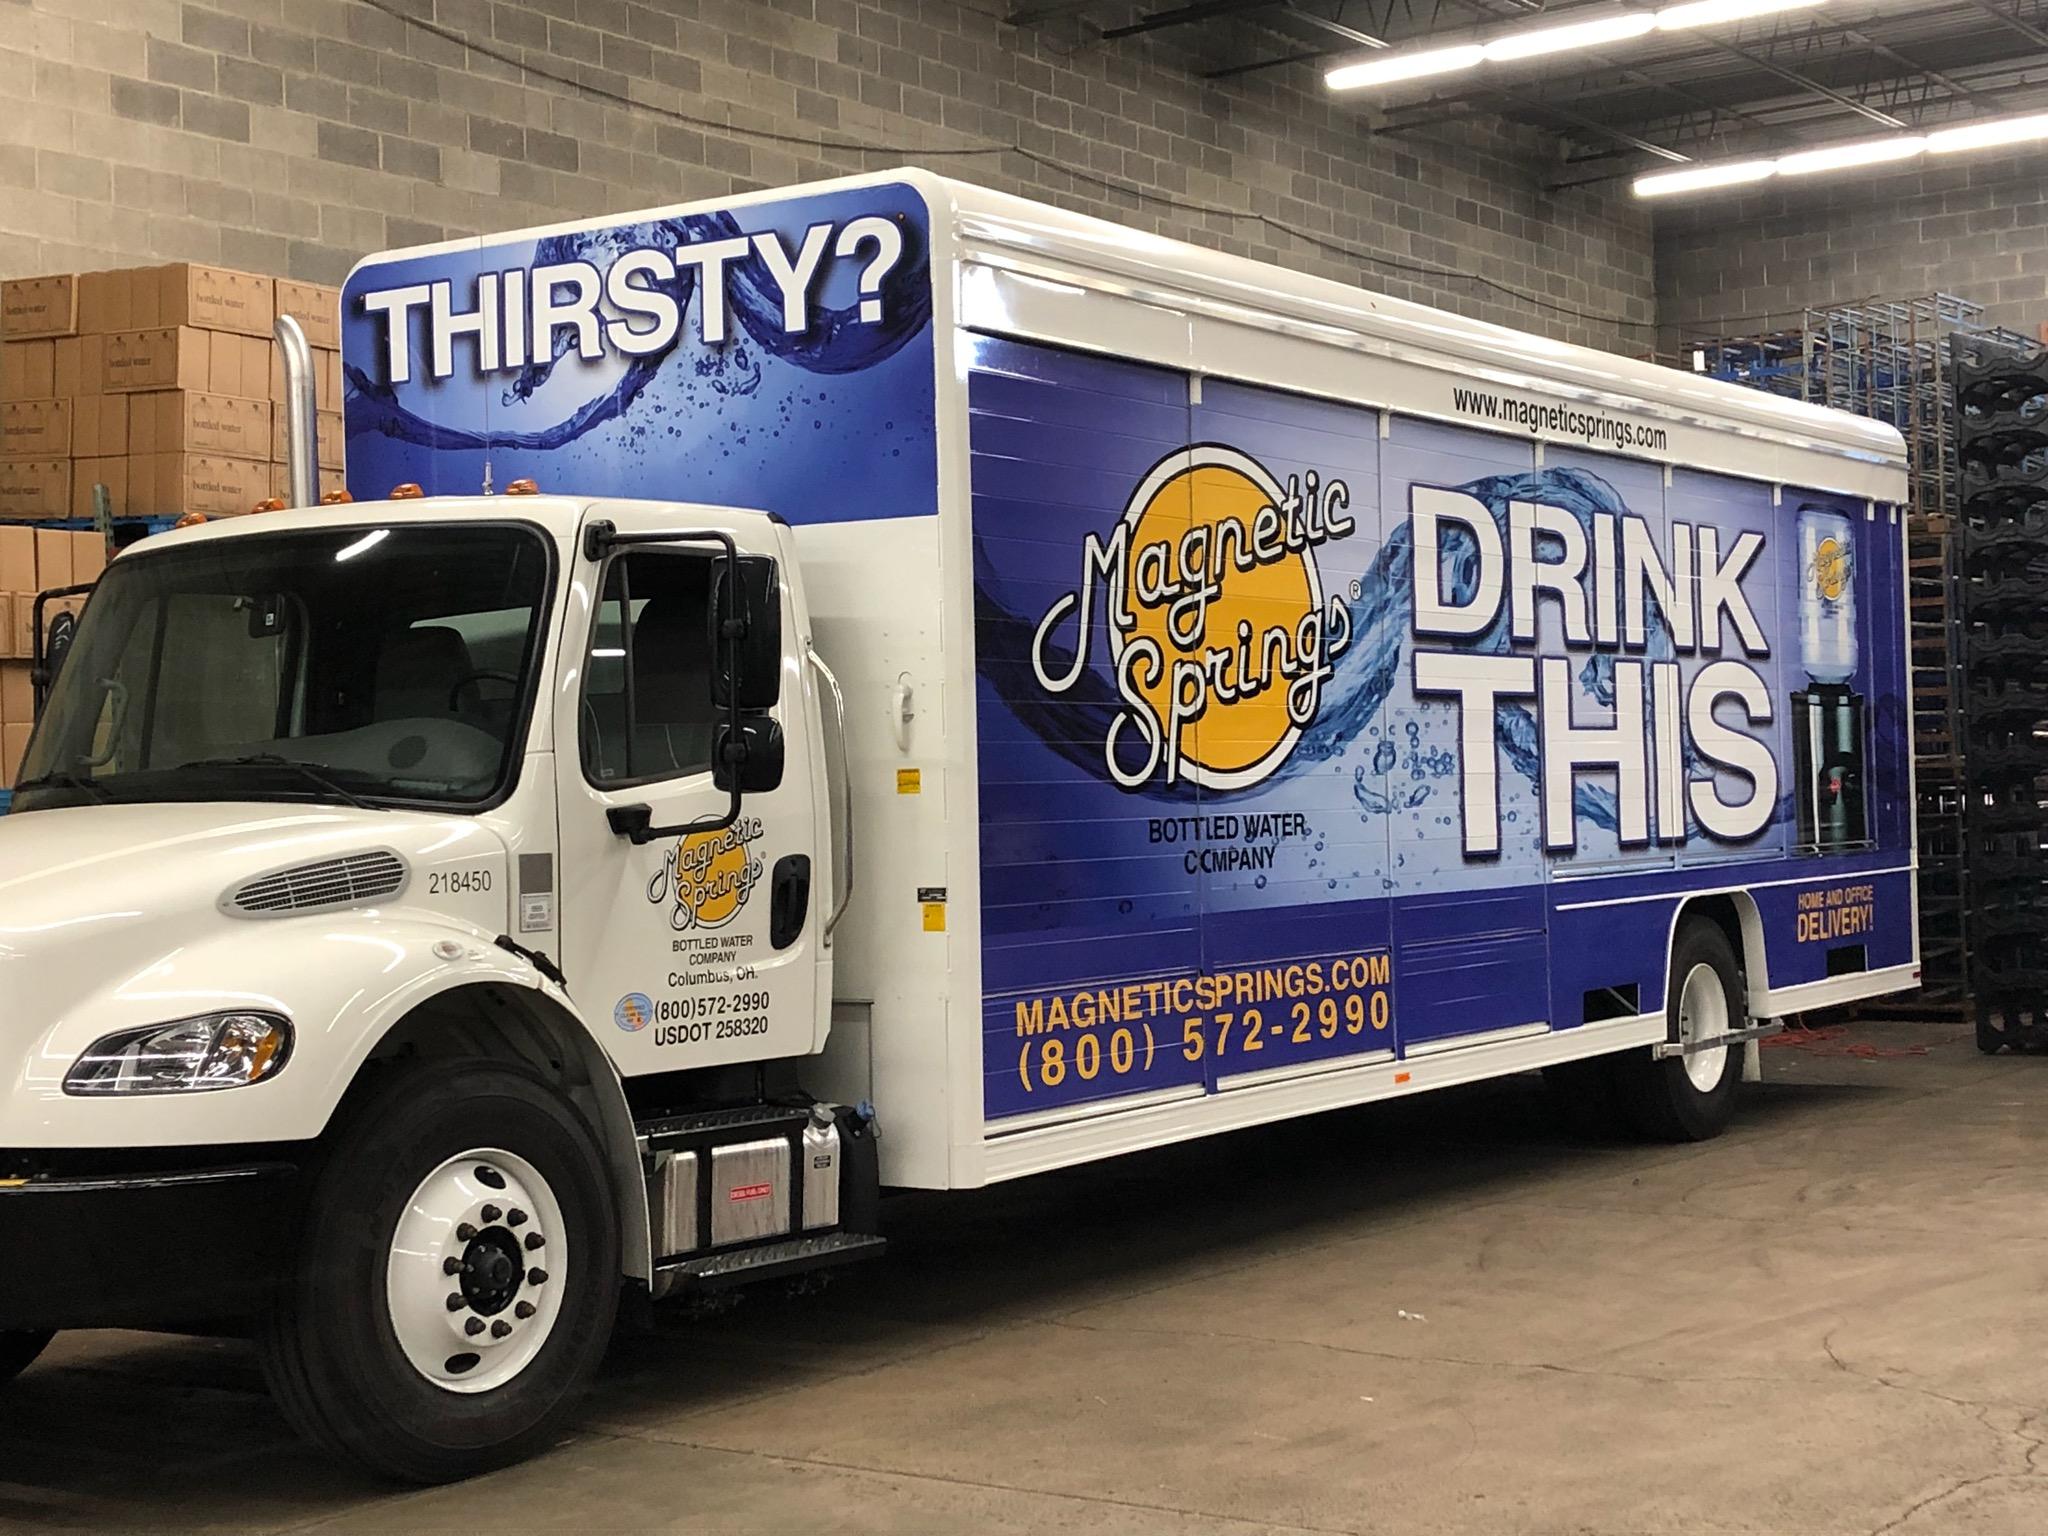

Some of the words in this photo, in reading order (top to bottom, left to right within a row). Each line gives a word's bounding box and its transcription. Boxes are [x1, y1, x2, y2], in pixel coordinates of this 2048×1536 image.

[364, 216, 903, 383] THIRSTY?
[1453, 388, 1667, 450] www.magneticsprings.com
[1031, 470, 1355, 693] Magnetic
[1410, 484, 1770, 656] DRINK
[1105, 594, 1353, 788] Springs
[1412, 651, 1779, 859] THIS
[1148, 815, 1239, 843] BOTTLED
[1243, 813, 1306, 839] WATER
[428, 870, 492, 894] 218450
[646, 816, 764, 904] Magnetic
[1184, 846, 1275, 874] COMPANY
[670, 857, 763, 931] Springs
[1798, 891, 1825, 911] HOME
[1826, 888, 1843, 907] AND
[1844, 884, 1873, 904] OFFICE
[672, 937, 719, 952] BOTTLED
[720, 934, 753, 948] WATER
[1797, 904, 1874, 943] DELIVERY!
[668, 968, 733, 987] Columbus,
[689, 951, 737, 966] COMPANY
[655, 991, 770, 1024] (800)572-2990
[1015, 955, 1391, 1038] MAGNETICSPRINGS.COM
[655, 1022, 712, 1046] USDOT
[716, 1015, 768, 1040] 258320
[1018, 1023, 1155, 1093] (800)
[1182, 990, 1390, 1062] 572-2990
